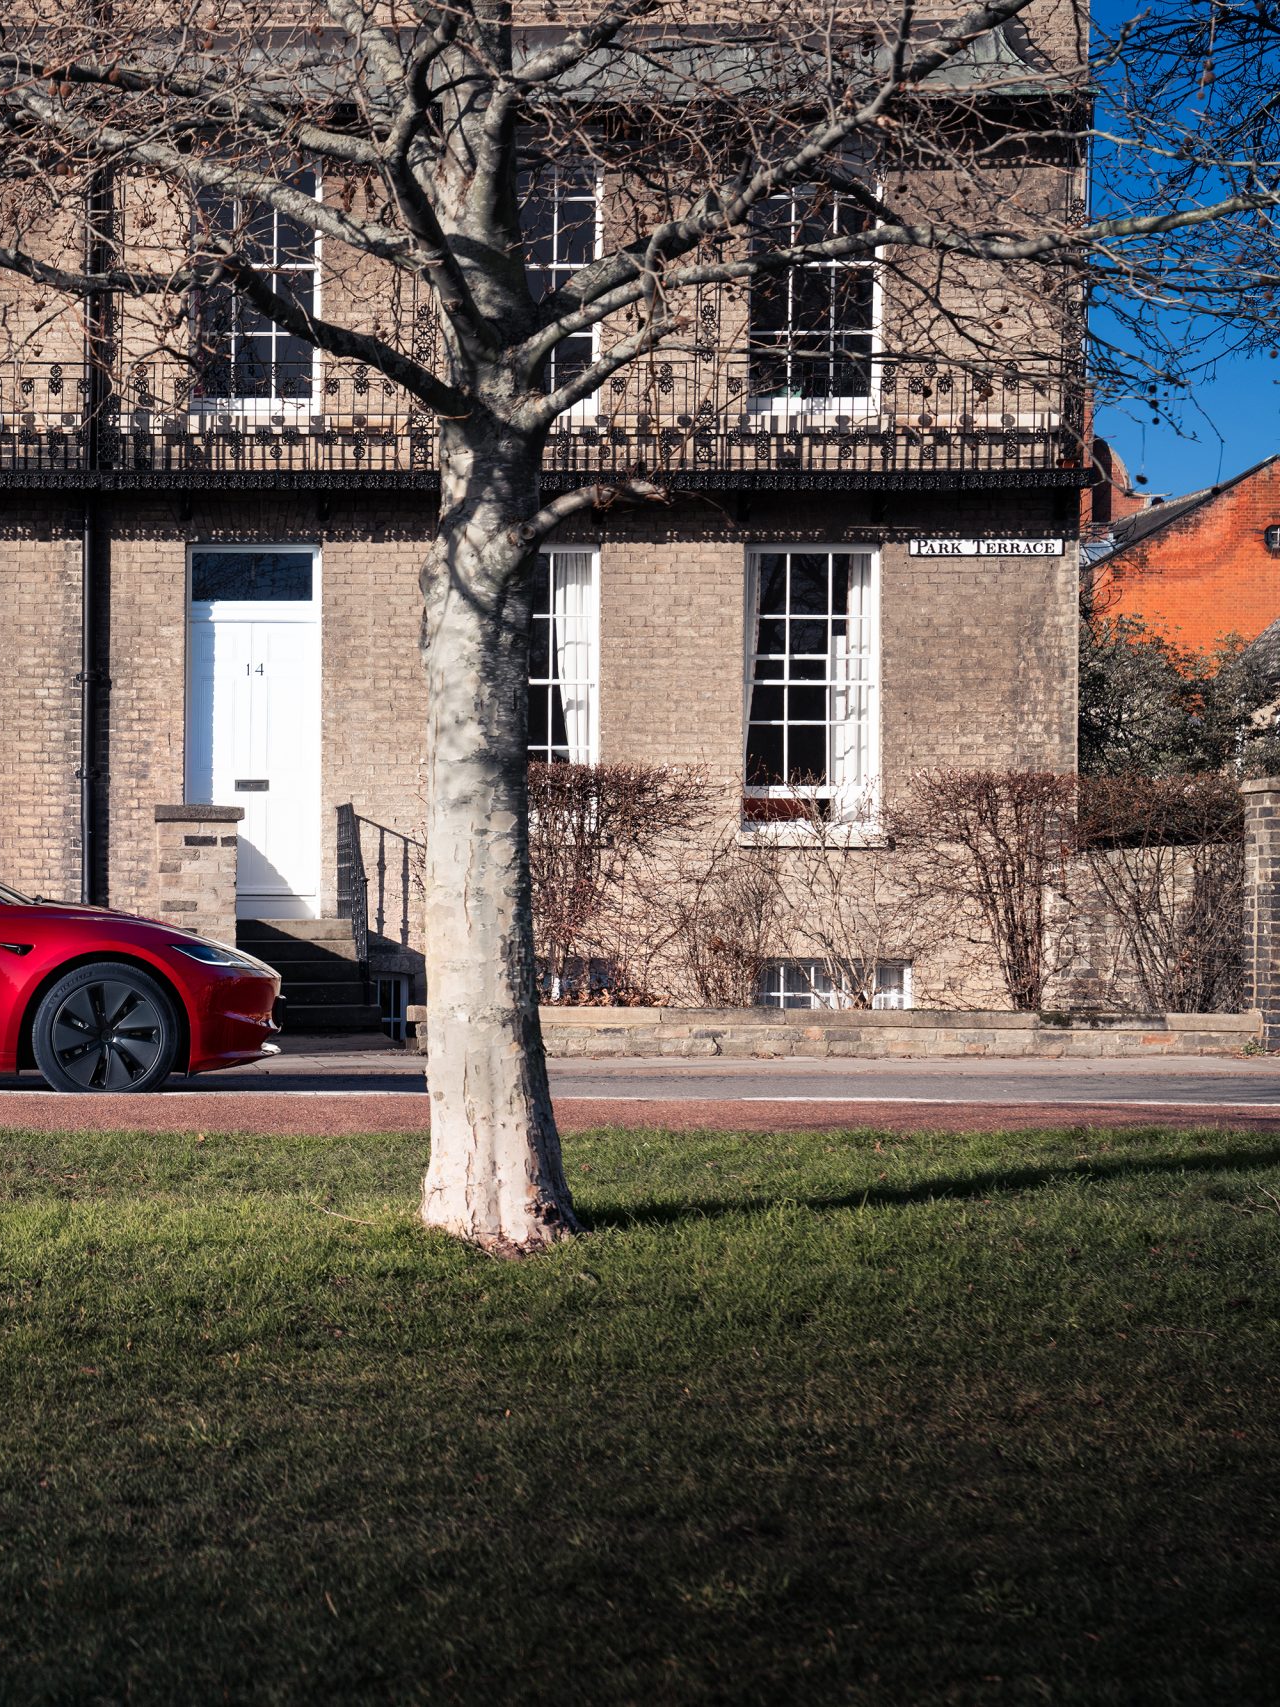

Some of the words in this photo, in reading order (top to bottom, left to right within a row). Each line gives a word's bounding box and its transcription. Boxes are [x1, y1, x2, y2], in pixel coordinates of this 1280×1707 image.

[915, 539, 962, 554] PARK
[972, 539, 1055, 554] TERRACE
[246, 662, 264, 676] 14
